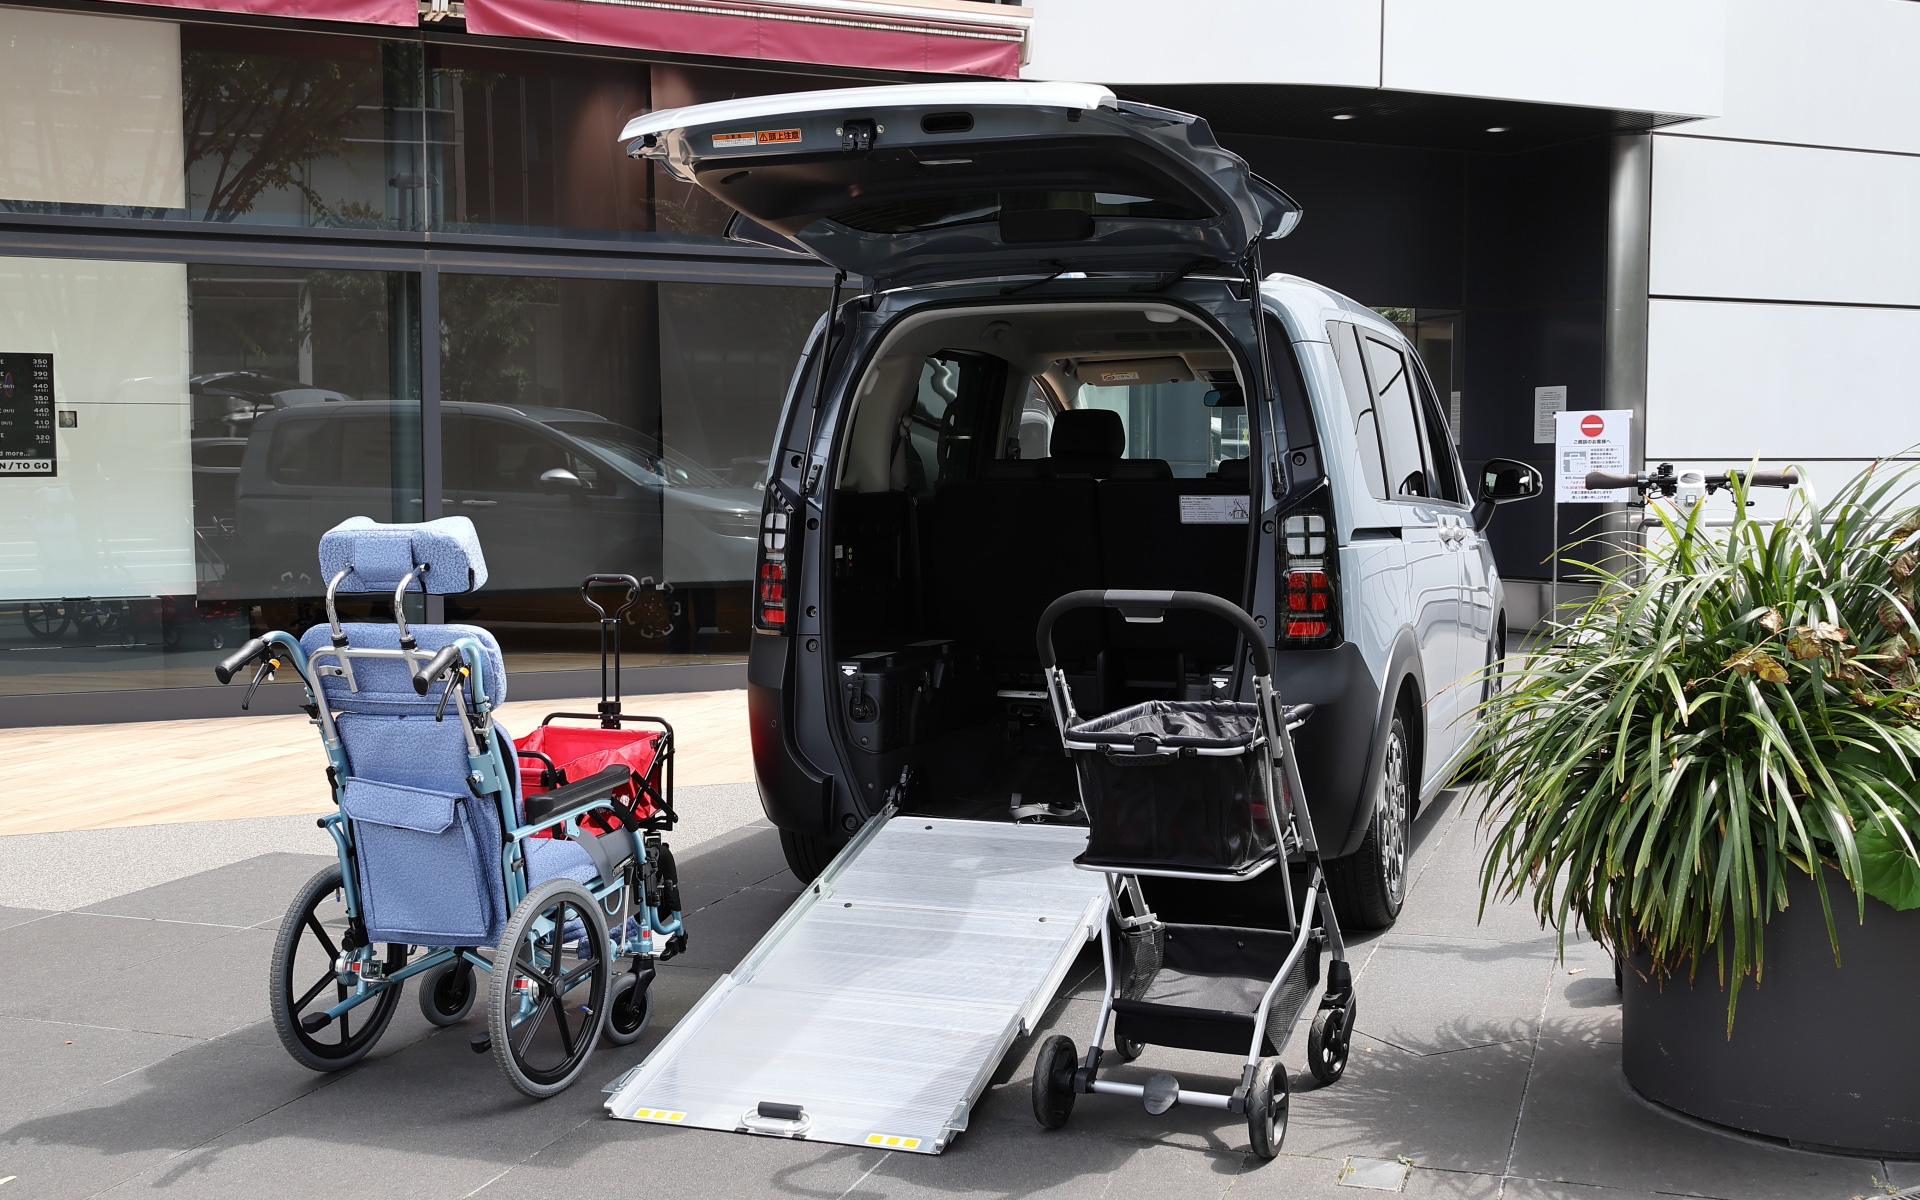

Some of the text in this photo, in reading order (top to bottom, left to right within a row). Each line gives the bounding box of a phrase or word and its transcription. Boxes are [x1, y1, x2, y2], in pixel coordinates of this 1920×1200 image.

[768, 131, 799, 141] 頭上注意
[34, 462, 49, 470] GO
